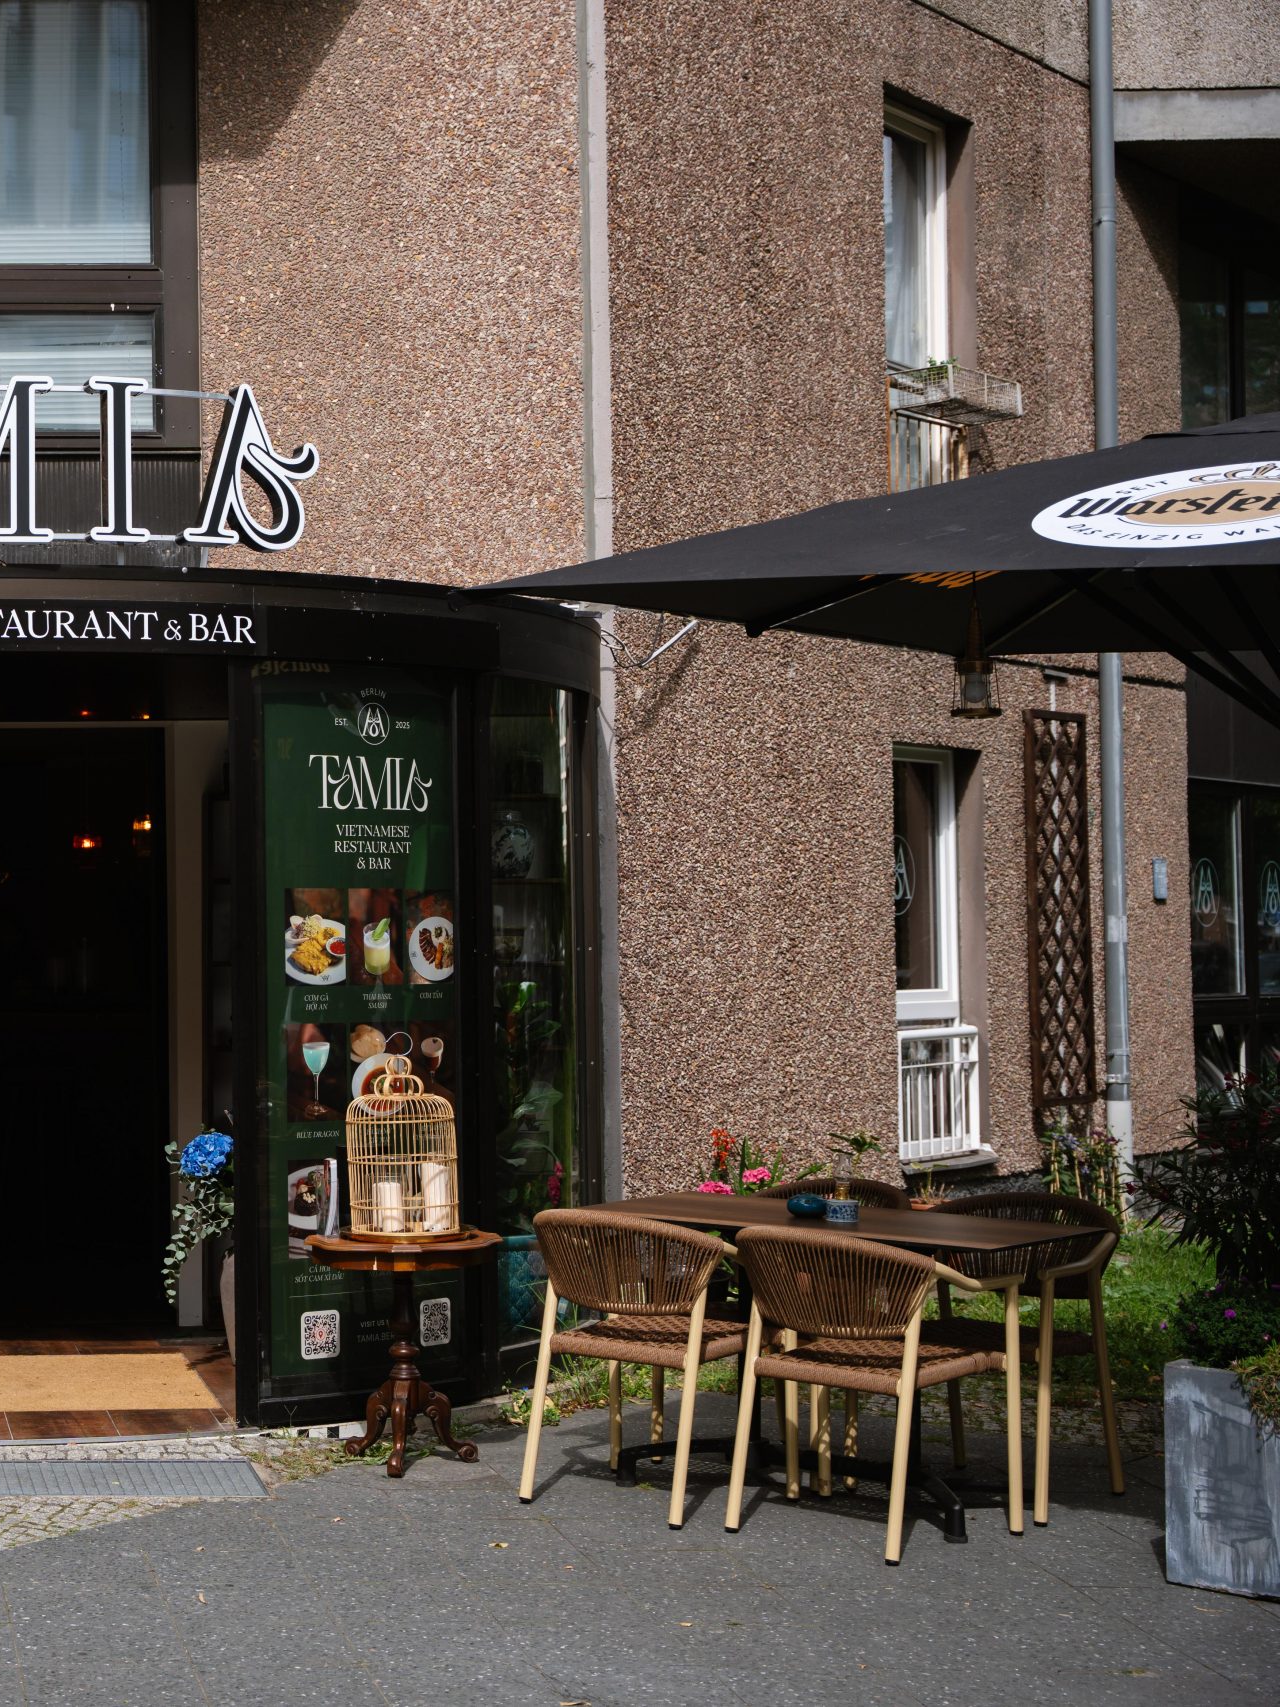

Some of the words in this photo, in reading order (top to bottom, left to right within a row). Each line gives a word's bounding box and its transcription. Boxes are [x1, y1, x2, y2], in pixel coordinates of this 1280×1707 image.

[1115, 479, 1169, 495] SEIT
[1066, 523, 1102, 535] DAS
[1103, 532, 1204, 542] EINZIG
[164, 617, 182, 642] &
[189, 614, 256, 645] BAR
[360, 688, 387, 700] BERLIN
[334, 718, 348, 726] EST.
[395, 721, 411, 730] 2025
[308, 754, 433, 812] TAMIA
[335, 824, 411, 838] VIETNAMESE
[334, 840, 412, 854] RESTAURANT
[356, 857, 366, 870] &
[369, 857, 392, 870] BAR
[296, 1131, 313, 1139] BLUE
[313, 1130, 340, 1138] DRAGON
[360, 1320, 376, 1328] VISIT
